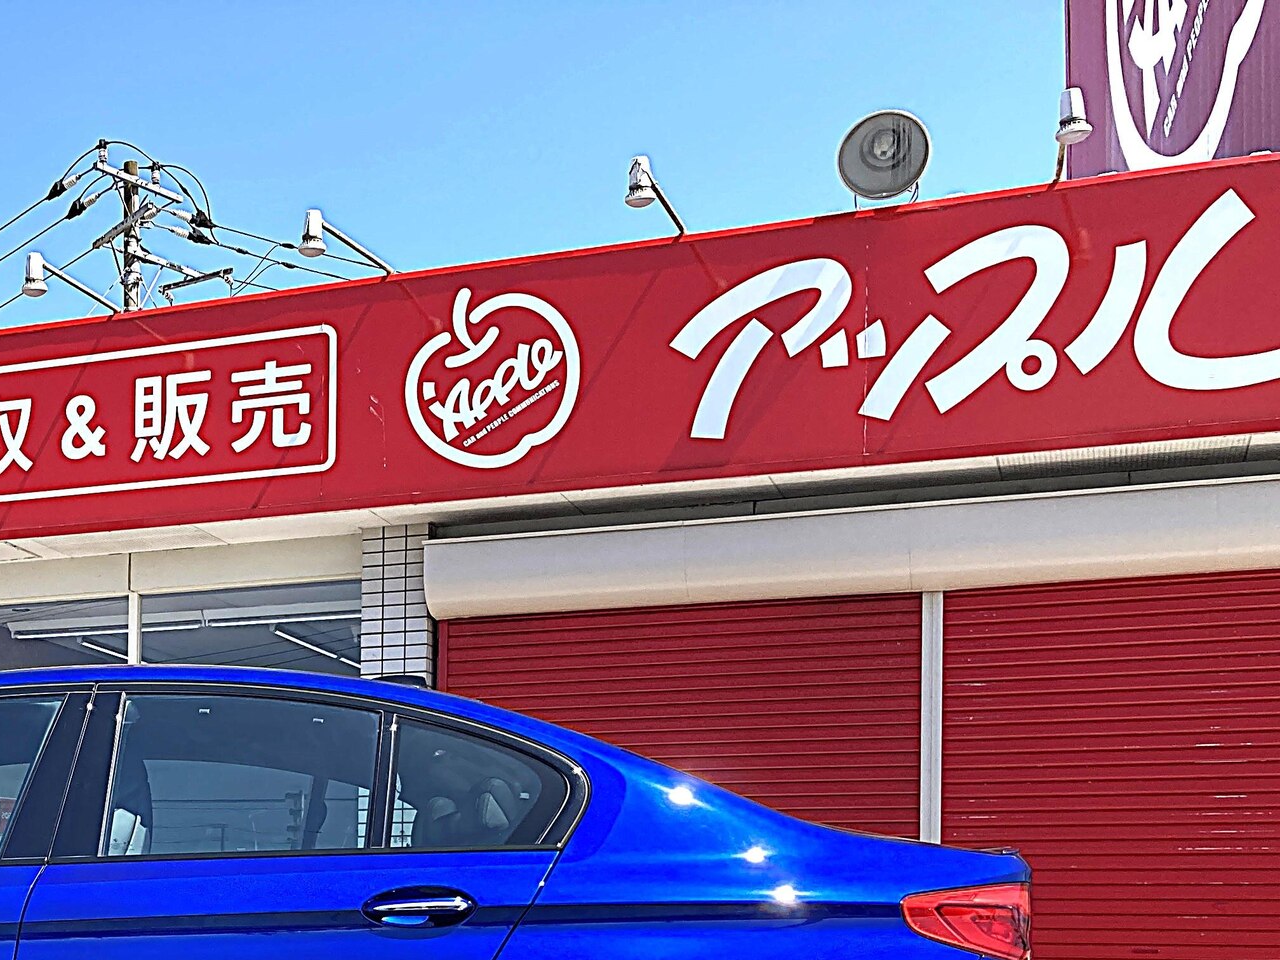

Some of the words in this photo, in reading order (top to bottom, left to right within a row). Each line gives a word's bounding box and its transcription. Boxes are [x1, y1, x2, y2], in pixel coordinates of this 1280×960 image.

[669, 188, 1280, 439] アップル
[463, 435, 477, 447] CAR
[486, 413, 509, 432] PEOPLE
[508, 379, 560, 417] COMMUNICATIONS
